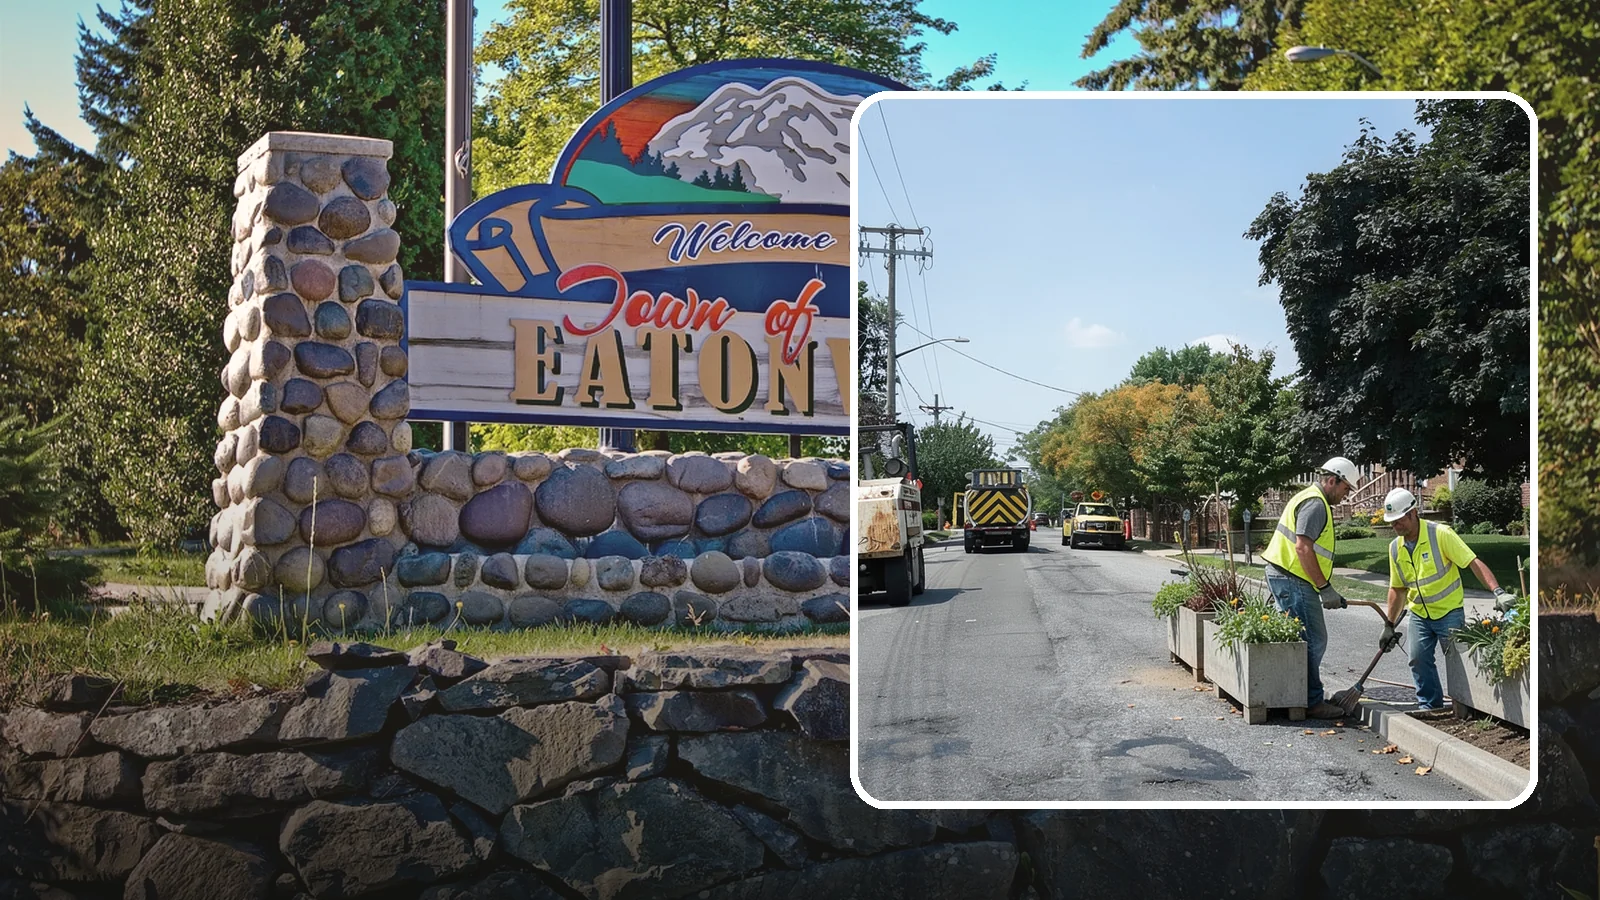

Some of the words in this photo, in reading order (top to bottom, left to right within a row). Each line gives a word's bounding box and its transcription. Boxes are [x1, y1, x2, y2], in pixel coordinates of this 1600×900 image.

[653, 220, 837, 264] Welcome
[556, 263, 738, 337] Town
[764, 278, 826, 366] of
